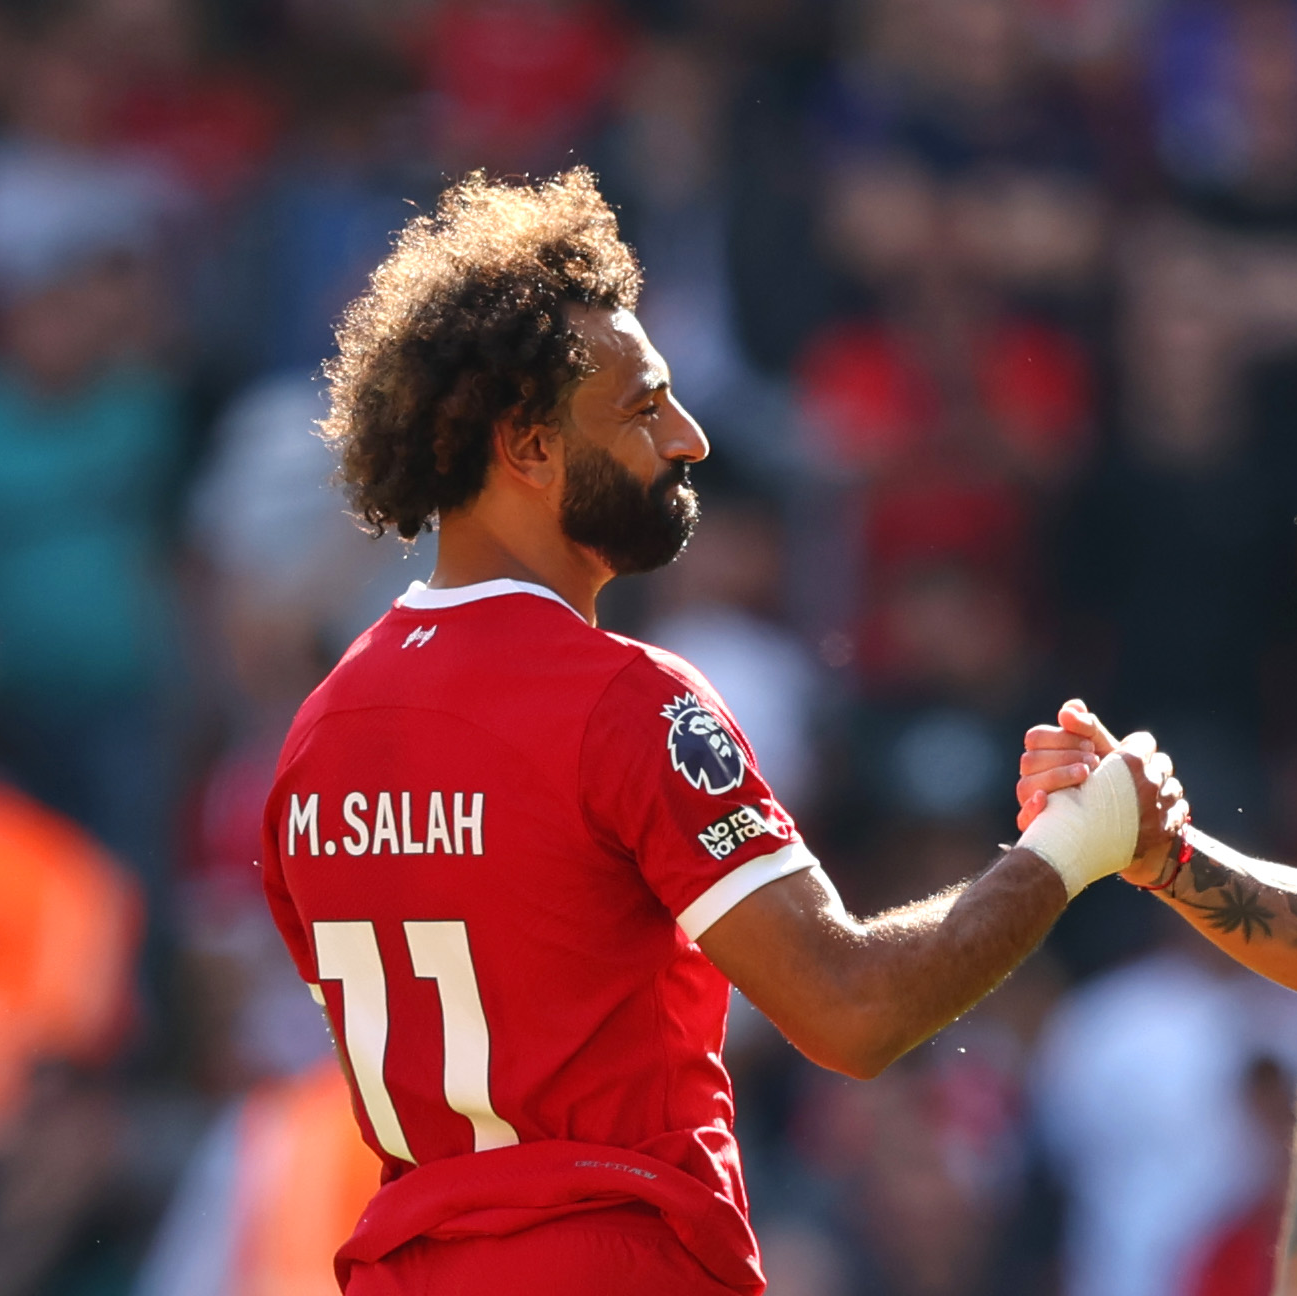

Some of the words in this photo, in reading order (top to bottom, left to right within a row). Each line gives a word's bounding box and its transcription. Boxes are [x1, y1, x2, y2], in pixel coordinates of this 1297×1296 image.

[698, 822, 729, 850] No
[709, 834, 736, 861] for
[312, 920, 519, 1165] 11
